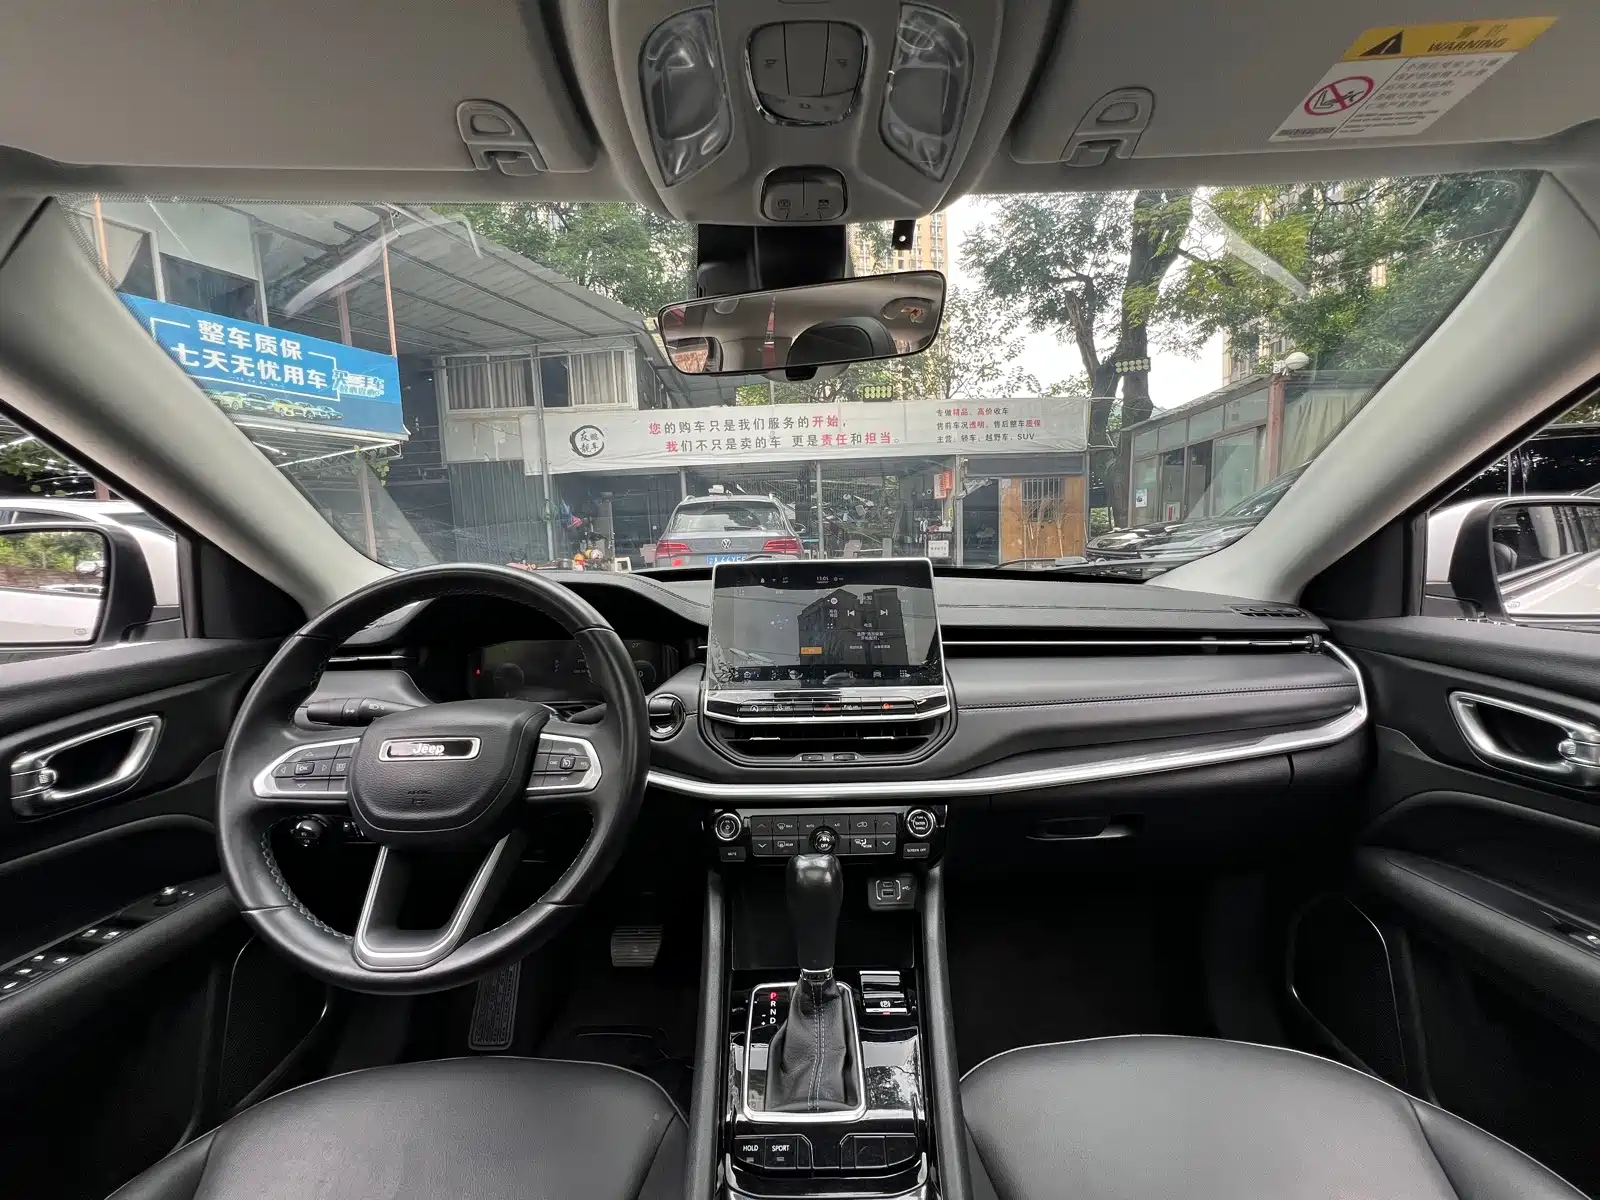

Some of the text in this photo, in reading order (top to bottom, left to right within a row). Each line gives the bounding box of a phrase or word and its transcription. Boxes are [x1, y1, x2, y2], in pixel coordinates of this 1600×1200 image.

[1428, 38, 1508, 52] WARNING
[197, 319, 303, 360] 整车质保
[171, 342, 328, 389] 七天无忧用车
[412, 743, 445, 756] Jeep
[769, 1017, 776, 1025] D
